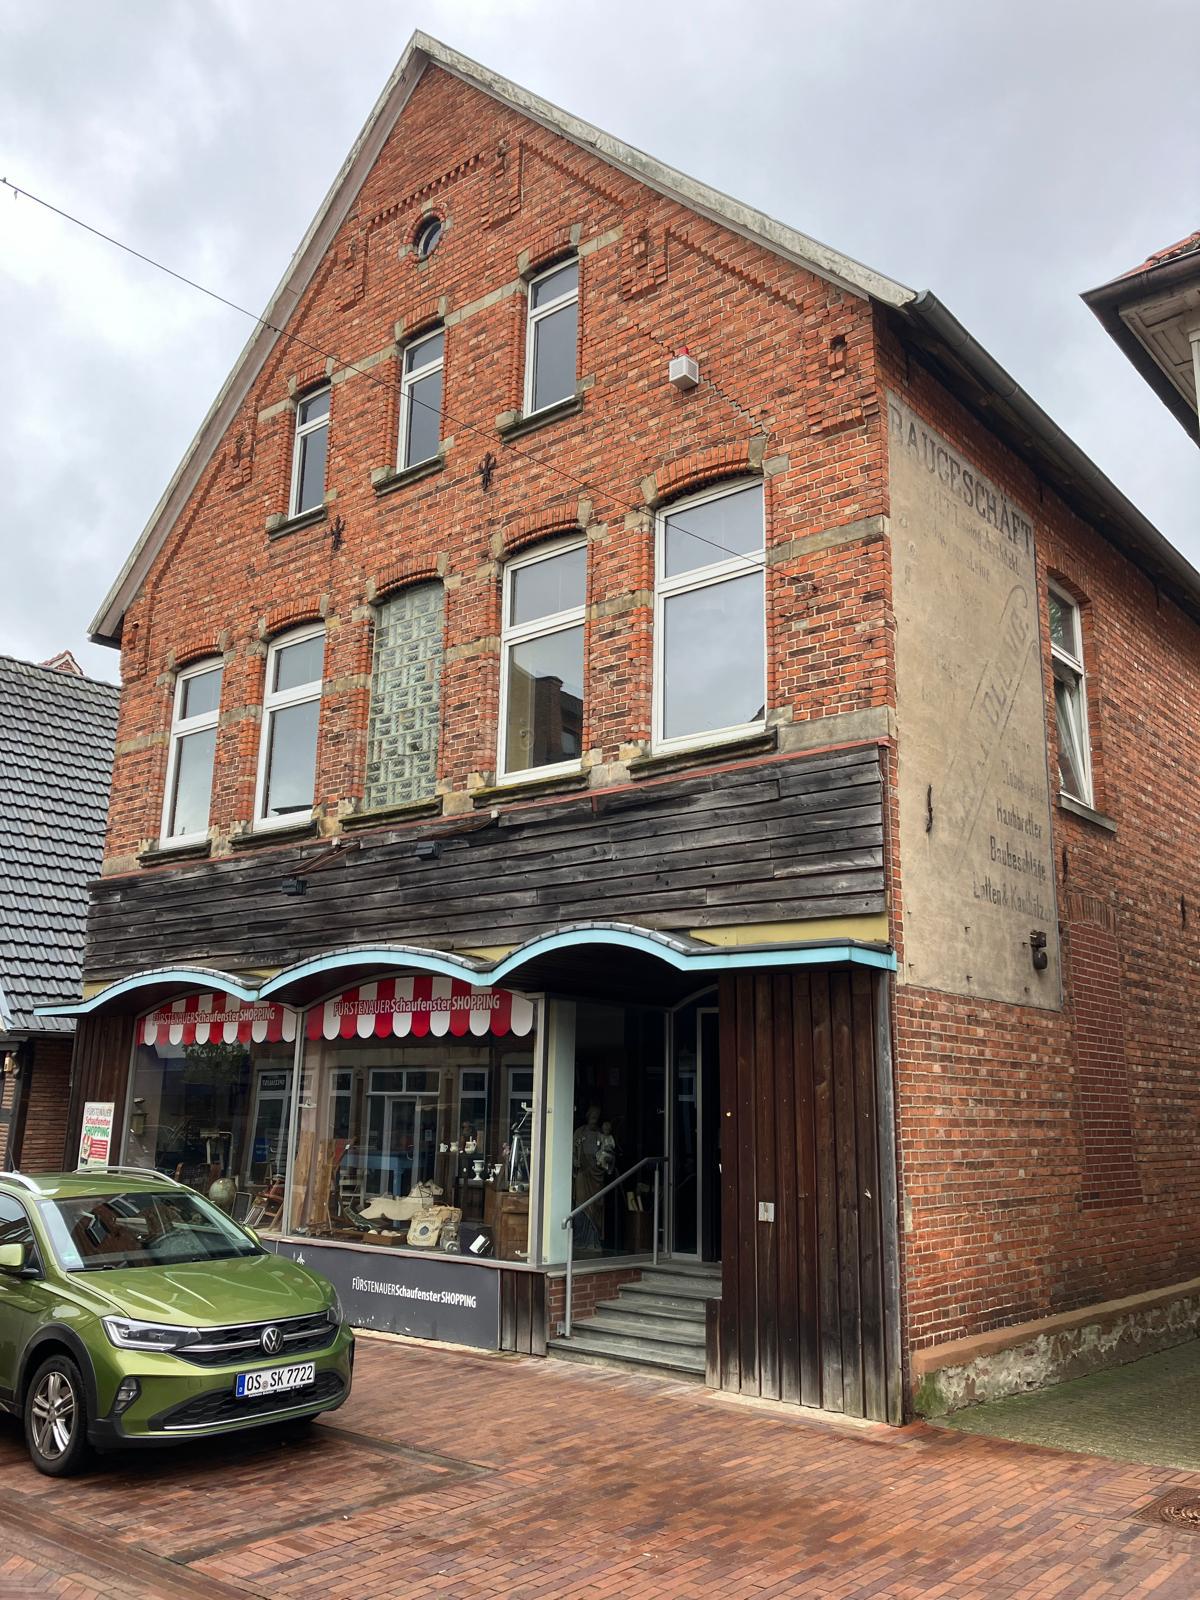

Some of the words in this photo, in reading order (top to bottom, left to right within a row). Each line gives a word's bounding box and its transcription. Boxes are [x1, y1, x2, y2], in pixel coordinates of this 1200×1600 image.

[888, 402, 1032, 555] BAUGESCHÄFT
[989, 835, 1046, 886] Baubeschläge
[246, 1374, 262, 1392] OS
[270, 1370, 285, 1387] SK
[286, 1365, 313, 1385] 7722
